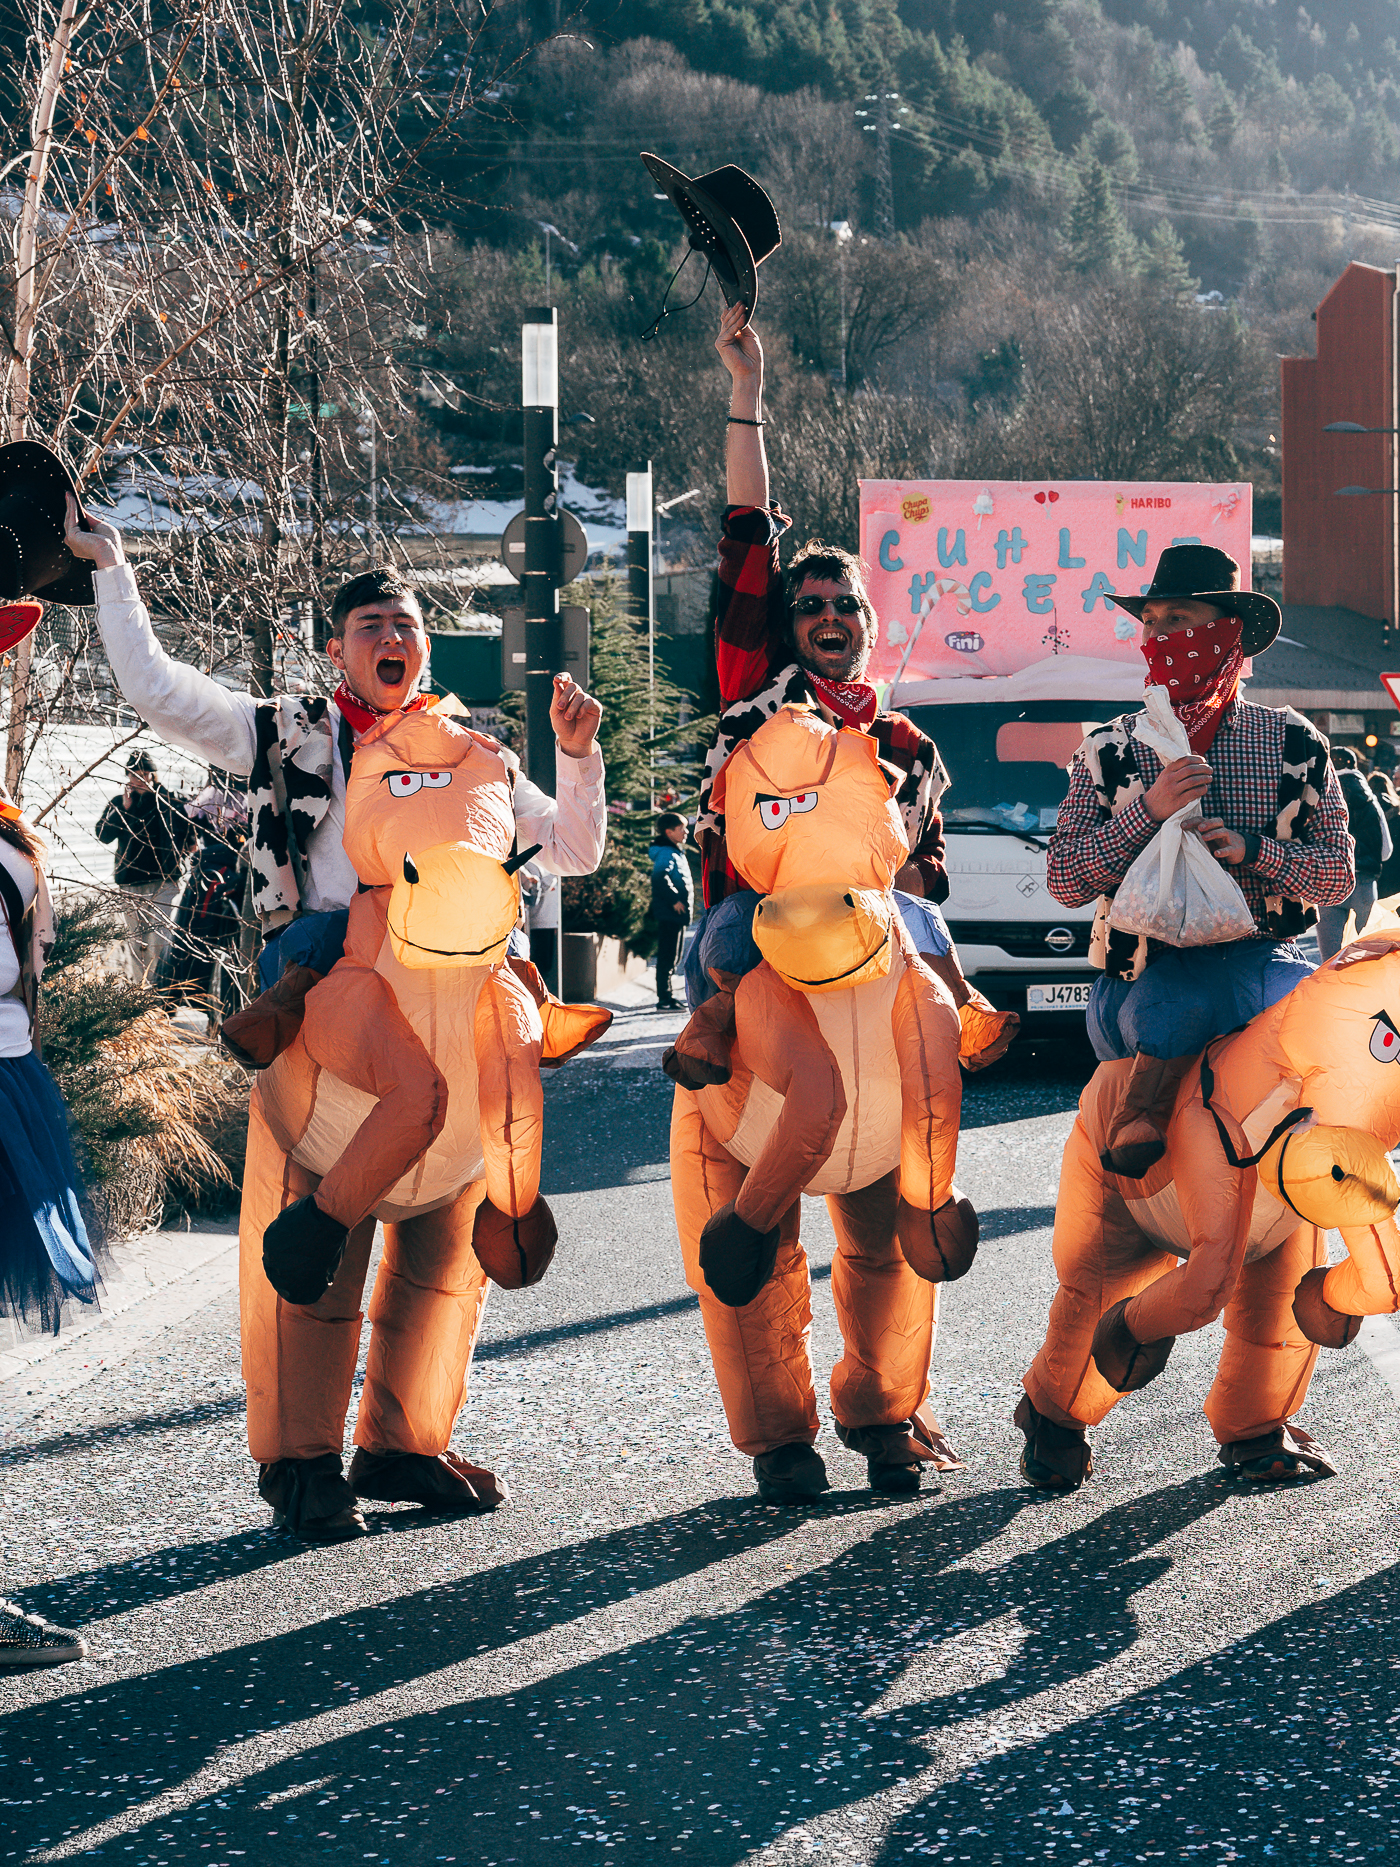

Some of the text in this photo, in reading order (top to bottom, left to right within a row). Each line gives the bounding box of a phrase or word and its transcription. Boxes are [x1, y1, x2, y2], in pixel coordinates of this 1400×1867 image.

[902, 498, 928, 510] Chupa
[1131, 497, 1172, 509] HARIBO
[903, 506, 930, 520] Chups
[948, 633, 981, 651] Fini
[1045, 986, 1090, 1003] J4783
